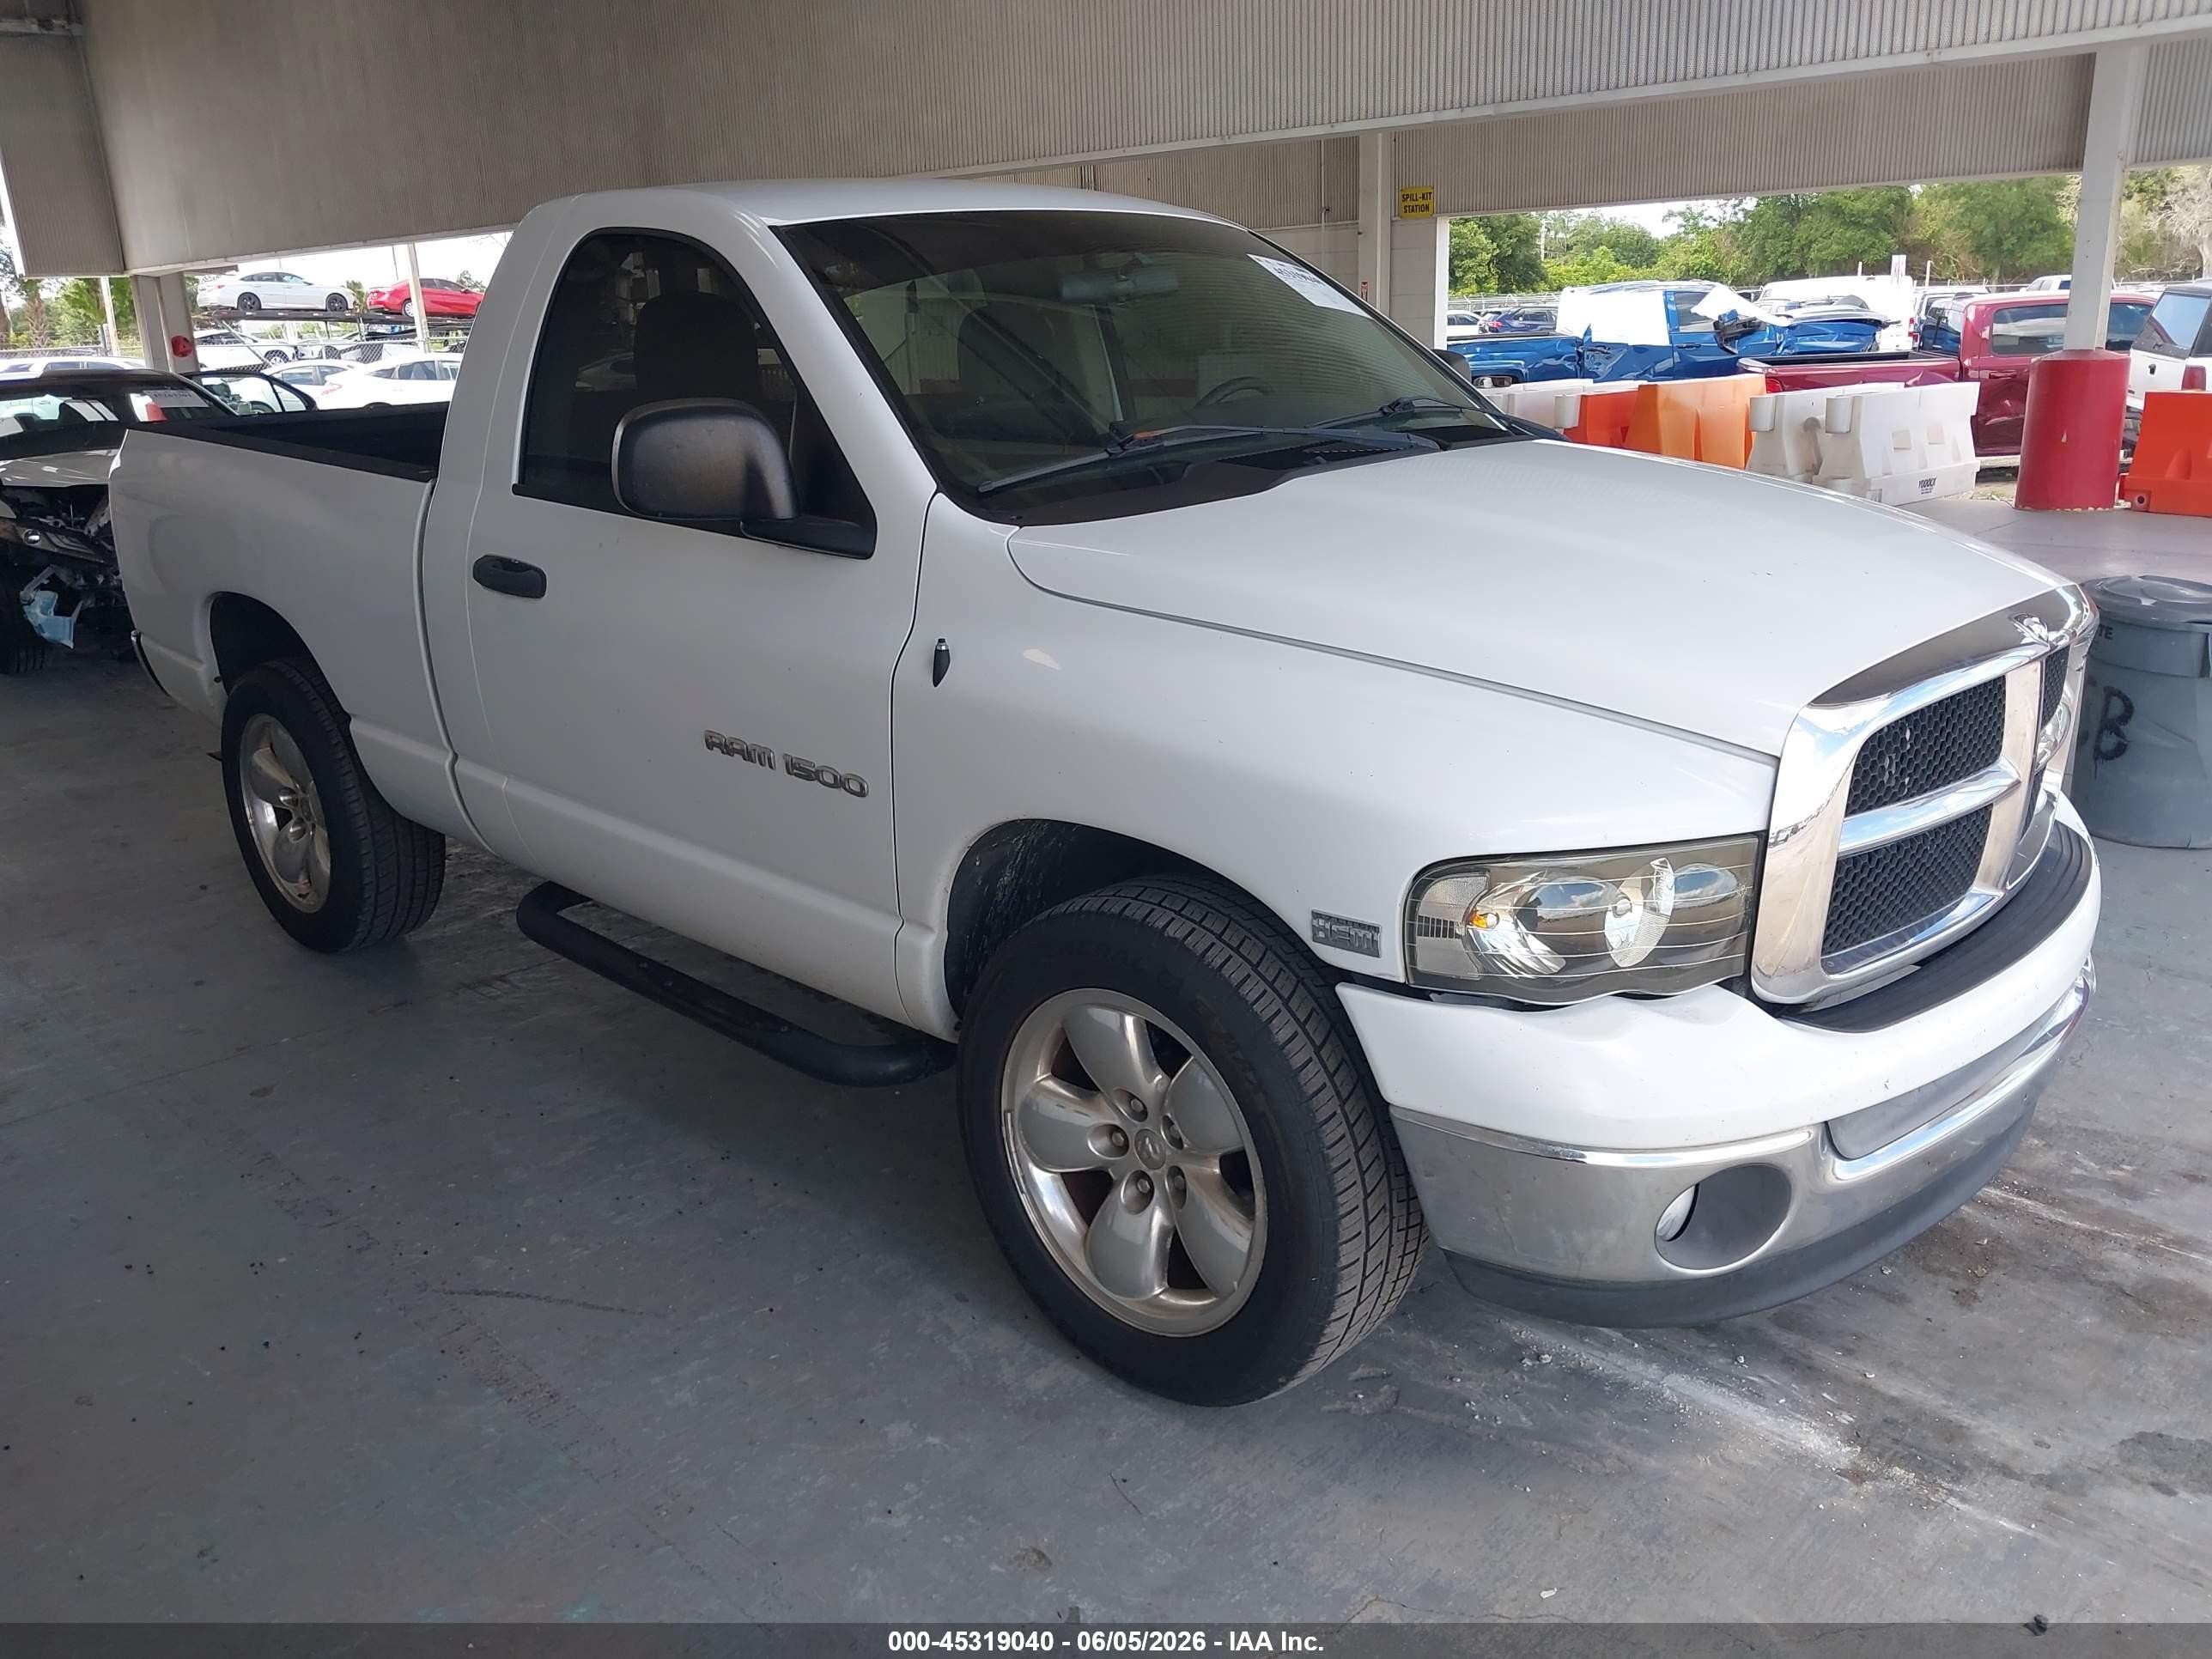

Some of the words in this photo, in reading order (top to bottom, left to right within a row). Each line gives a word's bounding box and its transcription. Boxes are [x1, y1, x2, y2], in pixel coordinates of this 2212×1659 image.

[1401, 191, 1432, 203] SPILL-KIT
[1403, 204, 1430, 214] STATION
[704, 729, 776, 771] RAM
[782, 753, 869, 798] 1500
[1312, 912, 1379, 954] HEMI
